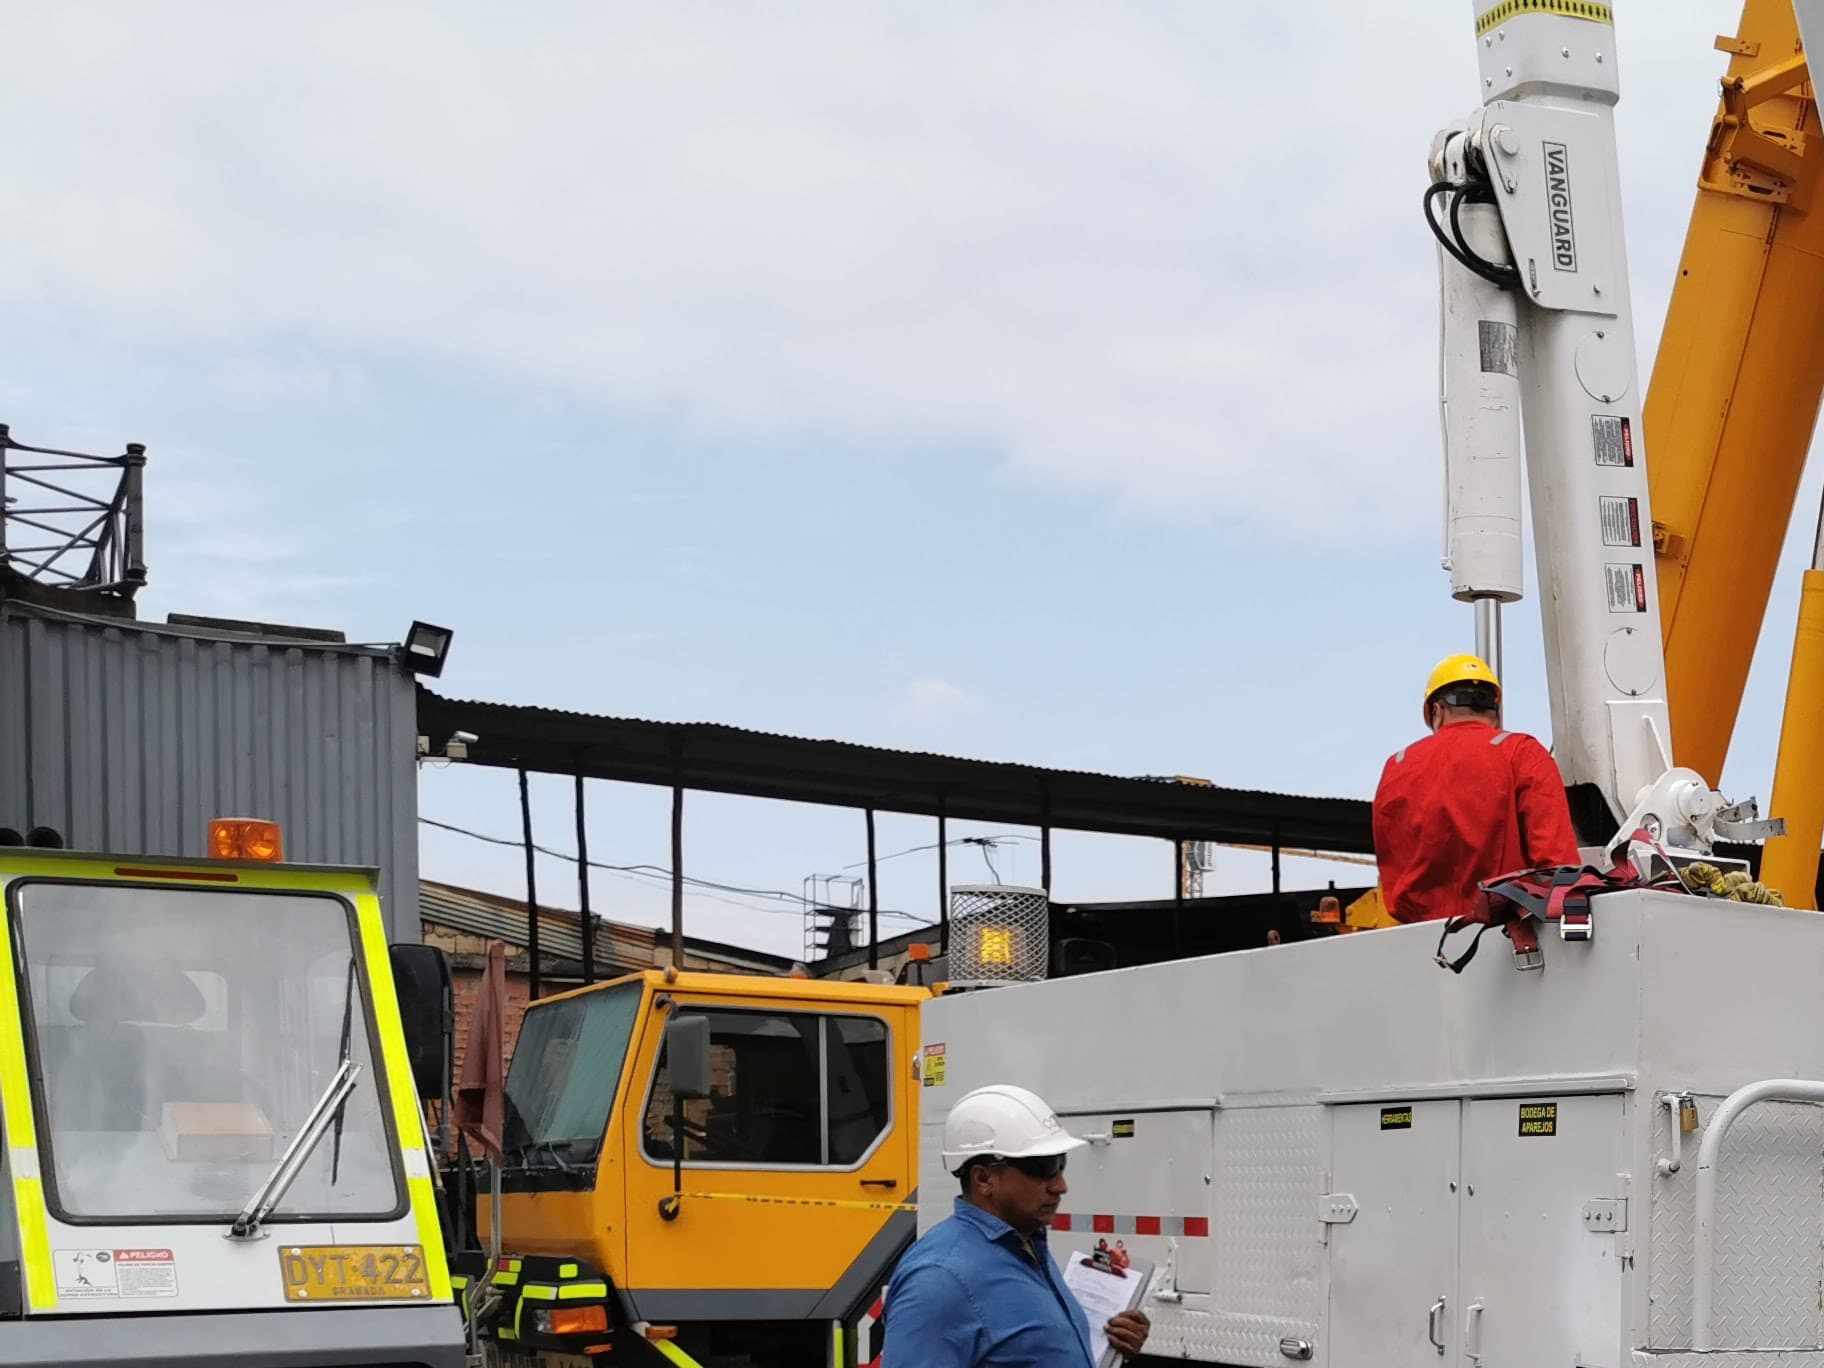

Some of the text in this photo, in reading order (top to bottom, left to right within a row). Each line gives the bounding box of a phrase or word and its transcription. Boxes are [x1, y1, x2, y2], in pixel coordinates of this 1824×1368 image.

[1548, 149, 1573, 267] VANGUARD
[1520, 1106, 1556, 1119] BODEGA DE
[1521, 1121, 1553, 1133] APAREJOS
